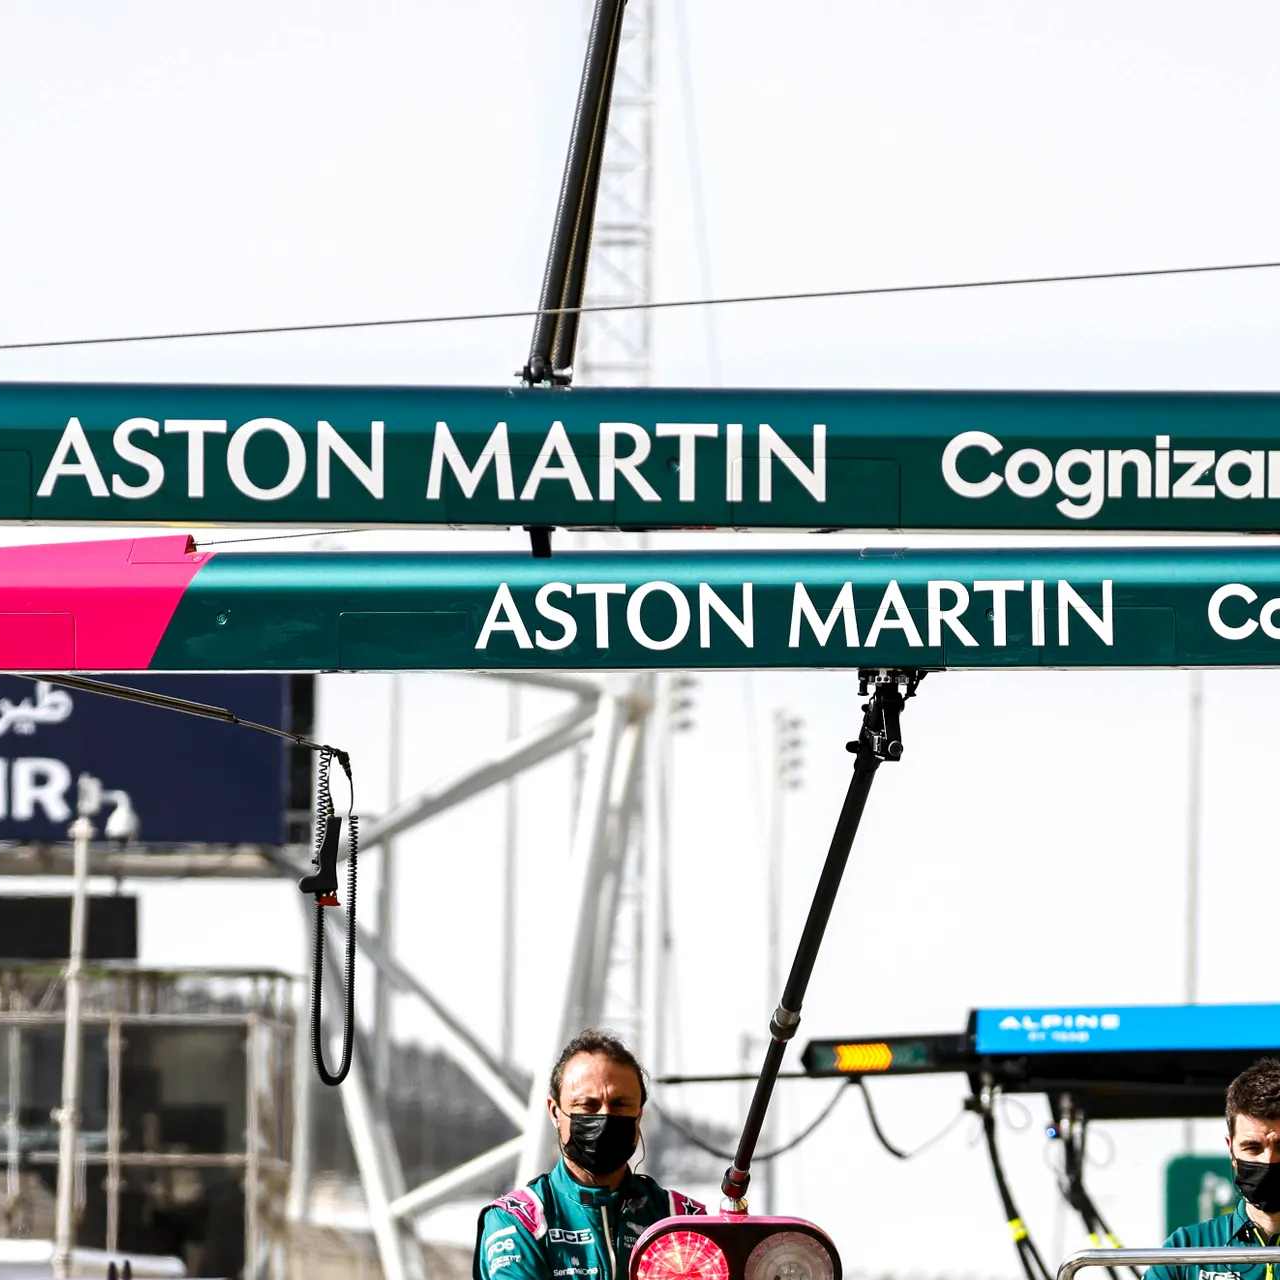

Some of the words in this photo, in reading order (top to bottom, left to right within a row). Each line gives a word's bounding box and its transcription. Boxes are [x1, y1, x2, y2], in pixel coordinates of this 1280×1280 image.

[36, 417, 385, 500] ASTON
[426, 420, 827, 502] MARTIN
[475, 581, 754, 650] ASTON
[788, 579, 1114, 648] MARTIN
[999, 1014, 1120, 1031] ALPINE
[549, 1228, 595, 1244] JCB
